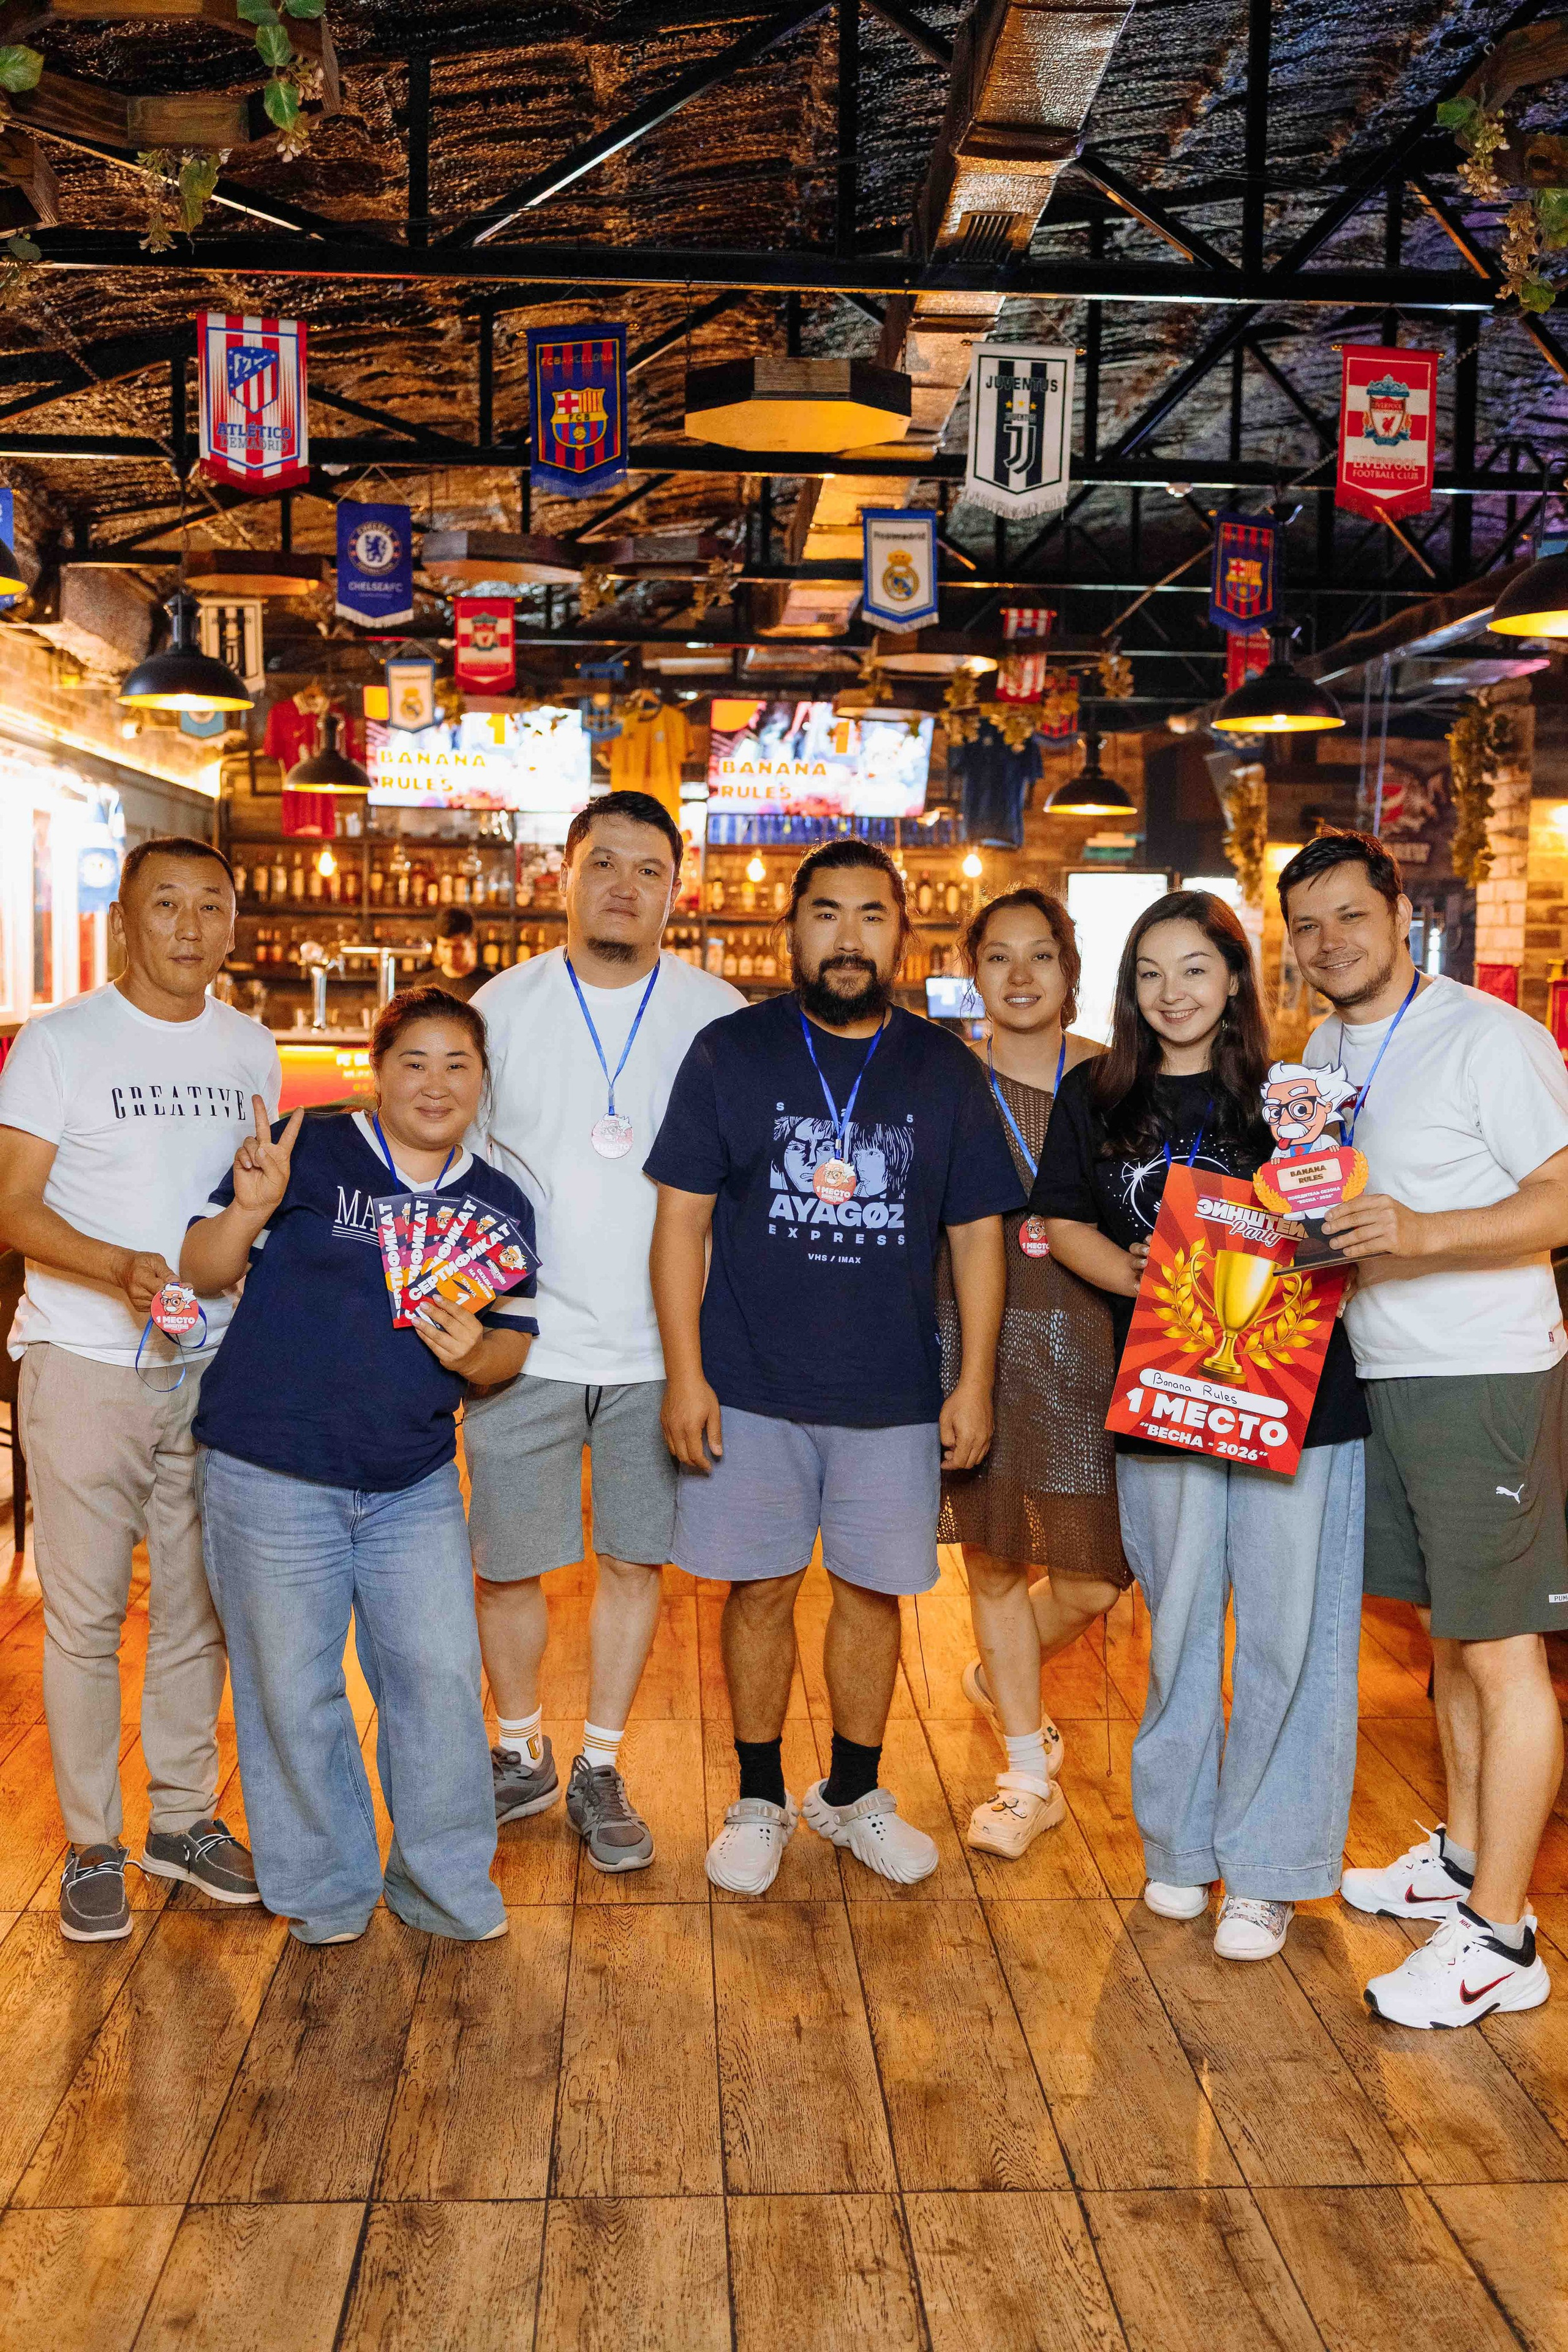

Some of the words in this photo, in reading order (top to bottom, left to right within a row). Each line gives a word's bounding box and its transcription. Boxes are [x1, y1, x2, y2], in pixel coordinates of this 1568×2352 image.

[986, 375, 1058, 393] JUVENTUS
[217, 421, 292, 440] ATLÉTICO
[1352, 454, 1419, 471] LIVERPOOL
[1352, 469, 1395, 480] FOOTBALL
[1397, 471, 1419, 480] CLUB
[380, 750, 486, 767] BANANA
[722, 761, 827, 775] BANANA
[380, 776, 453, 792] RULES
[721, 785, 791, 799] RULES
[111, 1085, 246, 1120] CREATIVE
[1290, 1164, 1327, 1177] BANANA
[1298, 1174, 1324, 1184] RULES
[821, 1186, 851, 1198] МЕСТО
[334, 1186, 379, 1233] MA
[1196, 1198, 1309, 1238] ЭЙНШТЕЙ
[769, 1224, 905, 1245] EXPRESS
[1229, 1219, 1283, 1248] Party
[409, 1223, 510, 1300] СЕРТИФИКАТ
[808, 1253, 827, 1262] VHS
[162, 1316, 195, 1324] МЕСТО
[1153, 1372, 1191, 1393] Banana
[1203, 1385, 1237, 1404] Rules
[1126, 1387, 1144, 1413] 1
[1152, 1393, 1289, 1447] МЕСТО
[1459, 1919, 1472, 1929] NIKE
